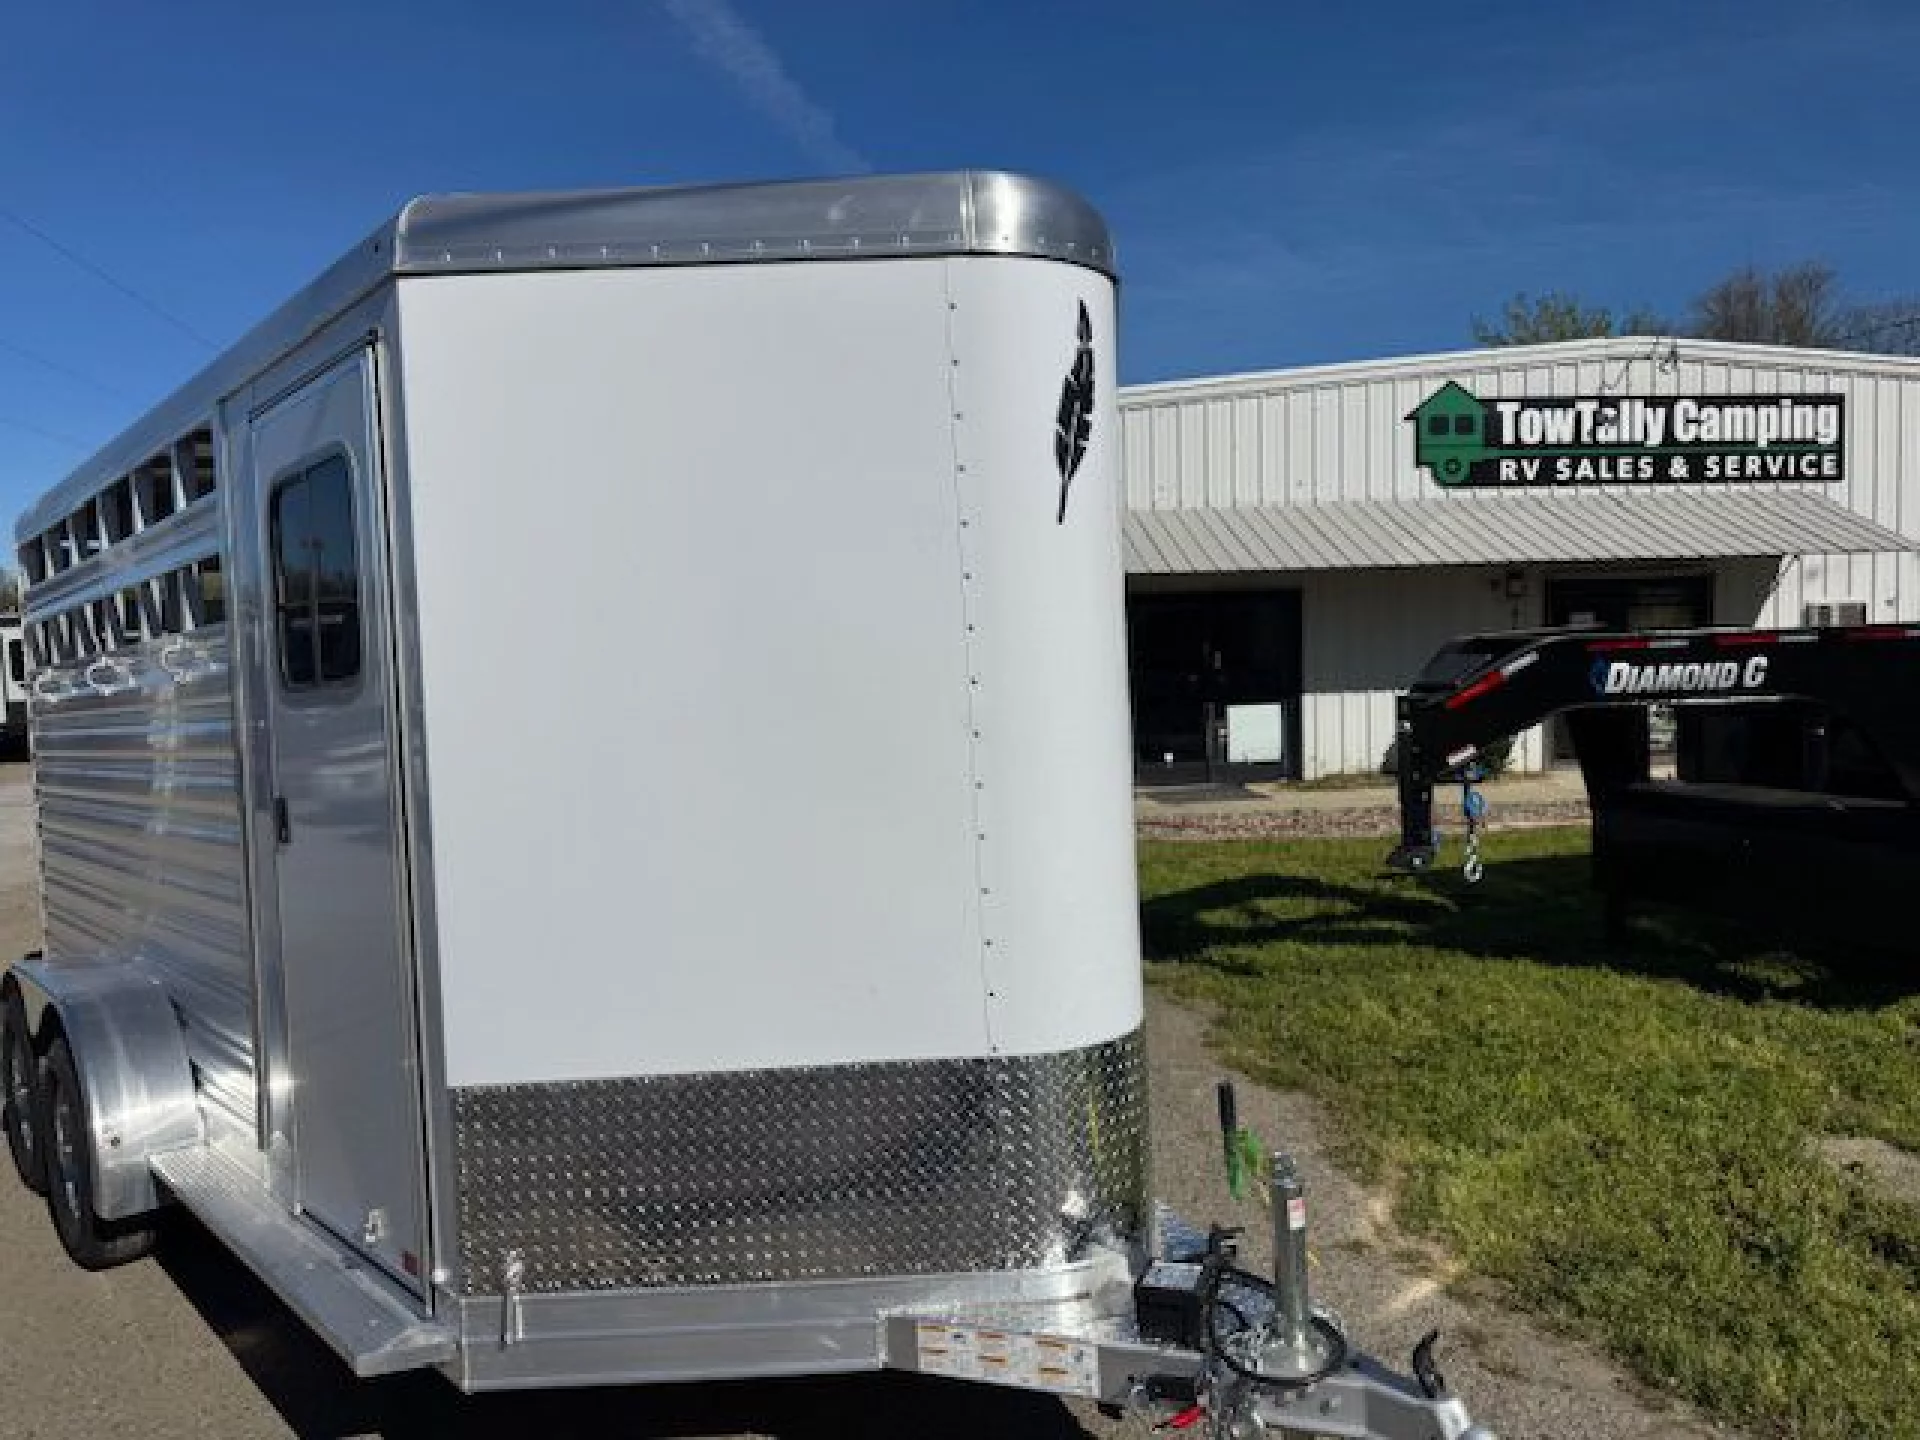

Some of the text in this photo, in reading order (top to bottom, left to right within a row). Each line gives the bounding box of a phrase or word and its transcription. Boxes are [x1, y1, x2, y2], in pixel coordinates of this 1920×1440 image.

[1497, 398, 1838, 447] TowTally Camping
[1499, 453, 1838, 480] RV SALES & SERVICE
[1604, 661, 1738, 693] DIAMOND
